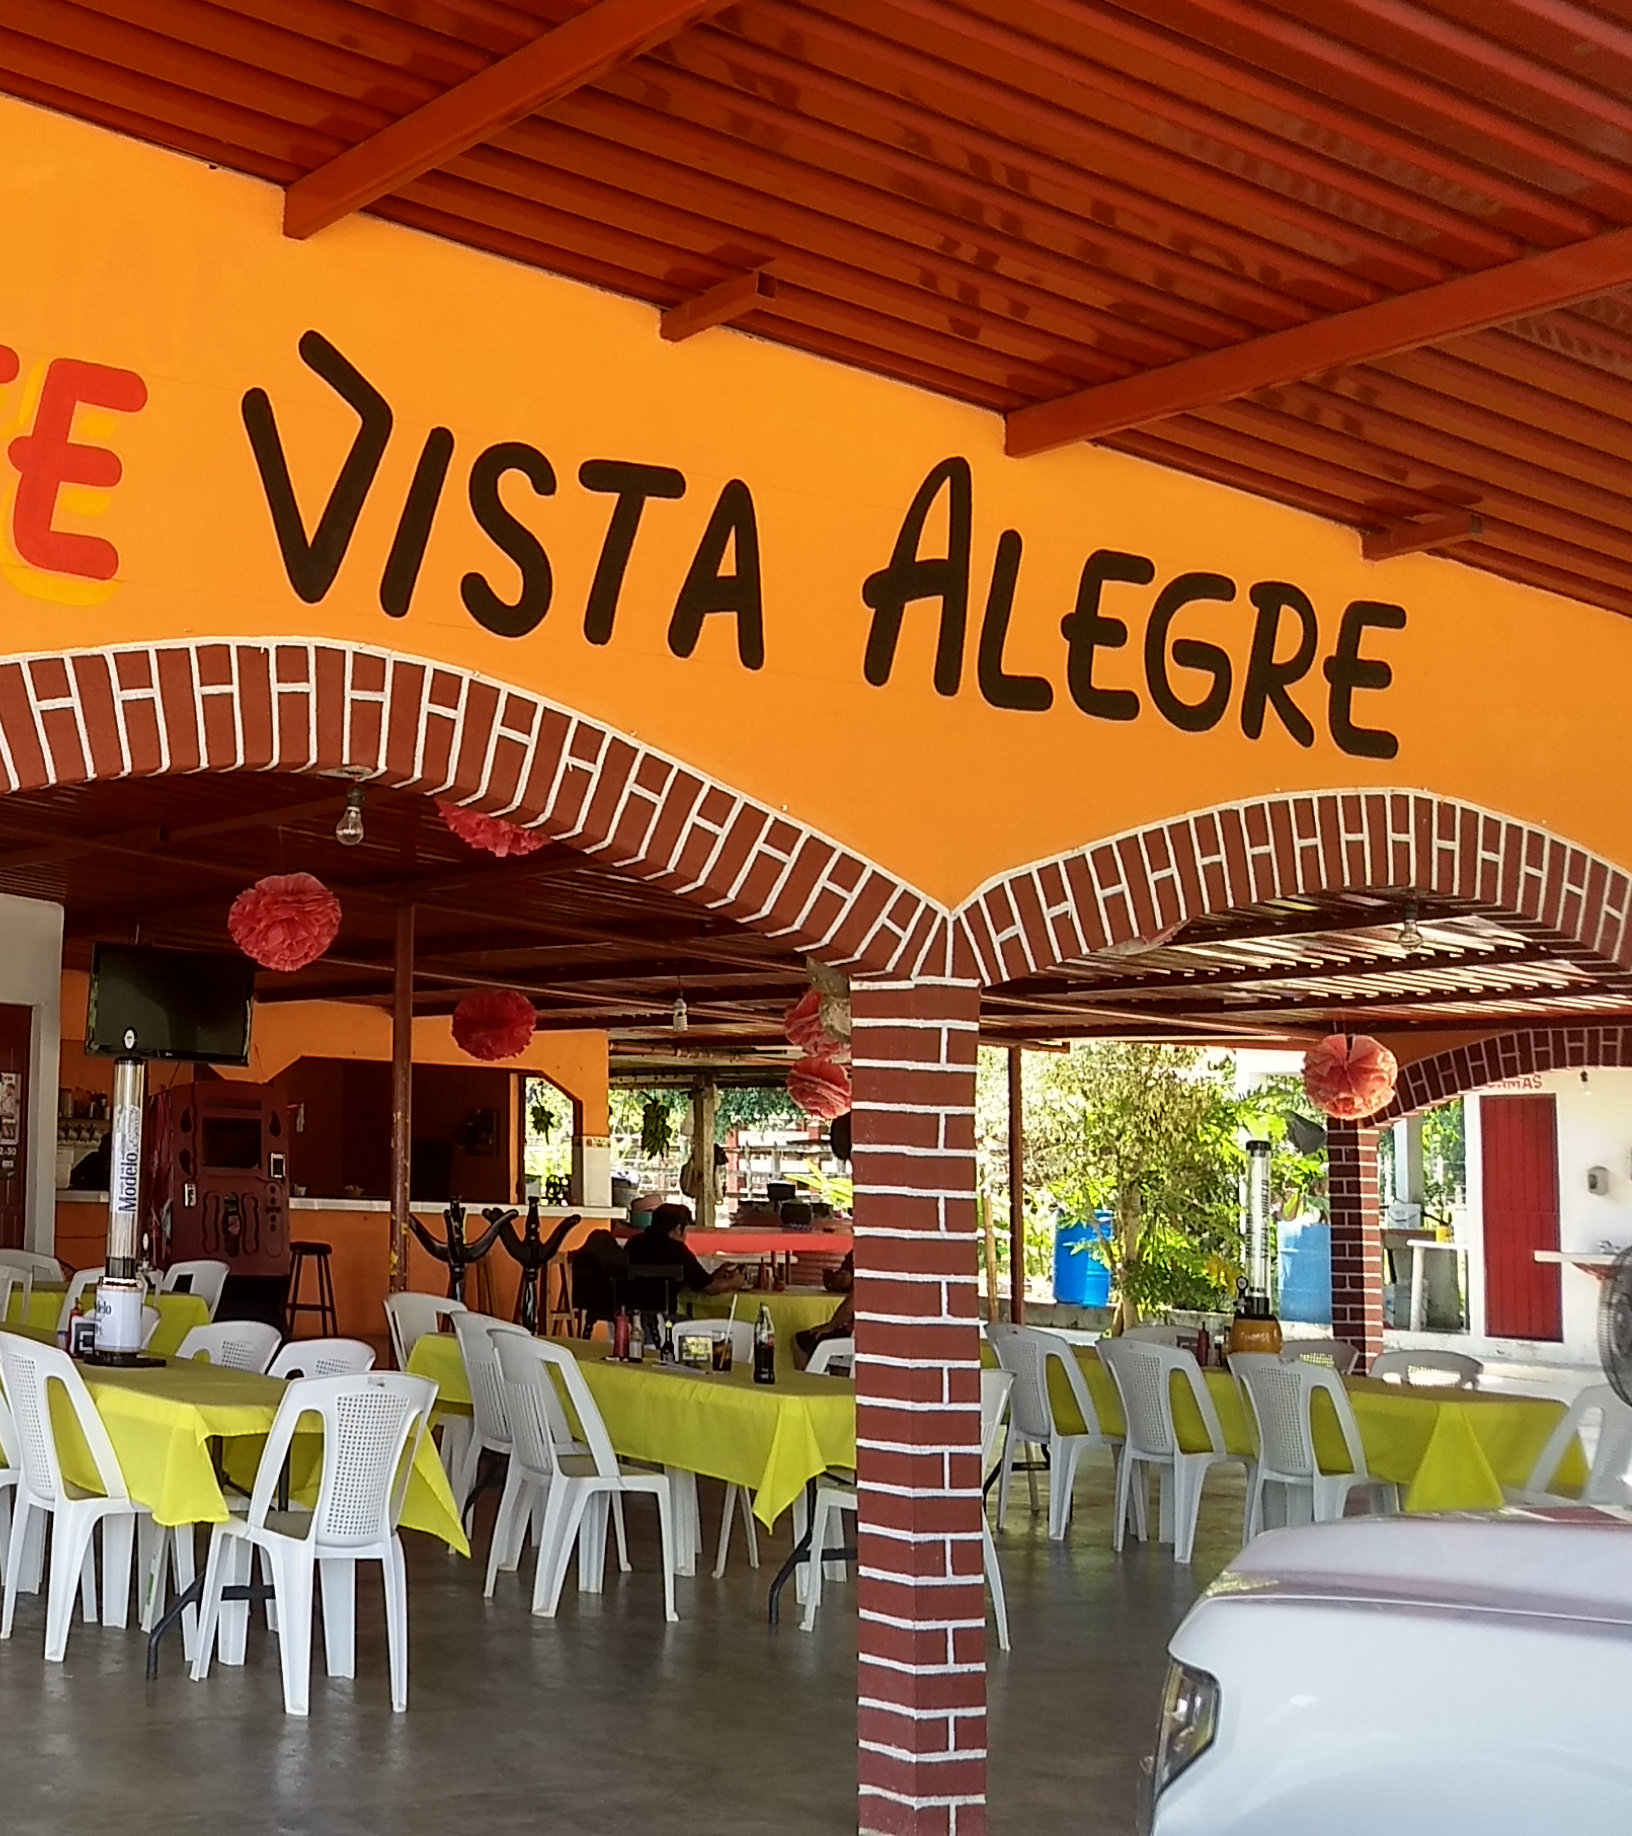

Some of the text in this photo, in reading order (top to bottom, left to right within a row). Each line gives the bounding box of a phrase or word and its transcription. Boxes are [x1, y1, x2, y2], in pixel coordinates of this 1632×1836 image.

[241, 329, 765, 672] VISTA
[861, 455, 1407, 761] ALEGRE
[118, 1152, 139, 1213] Modelo
